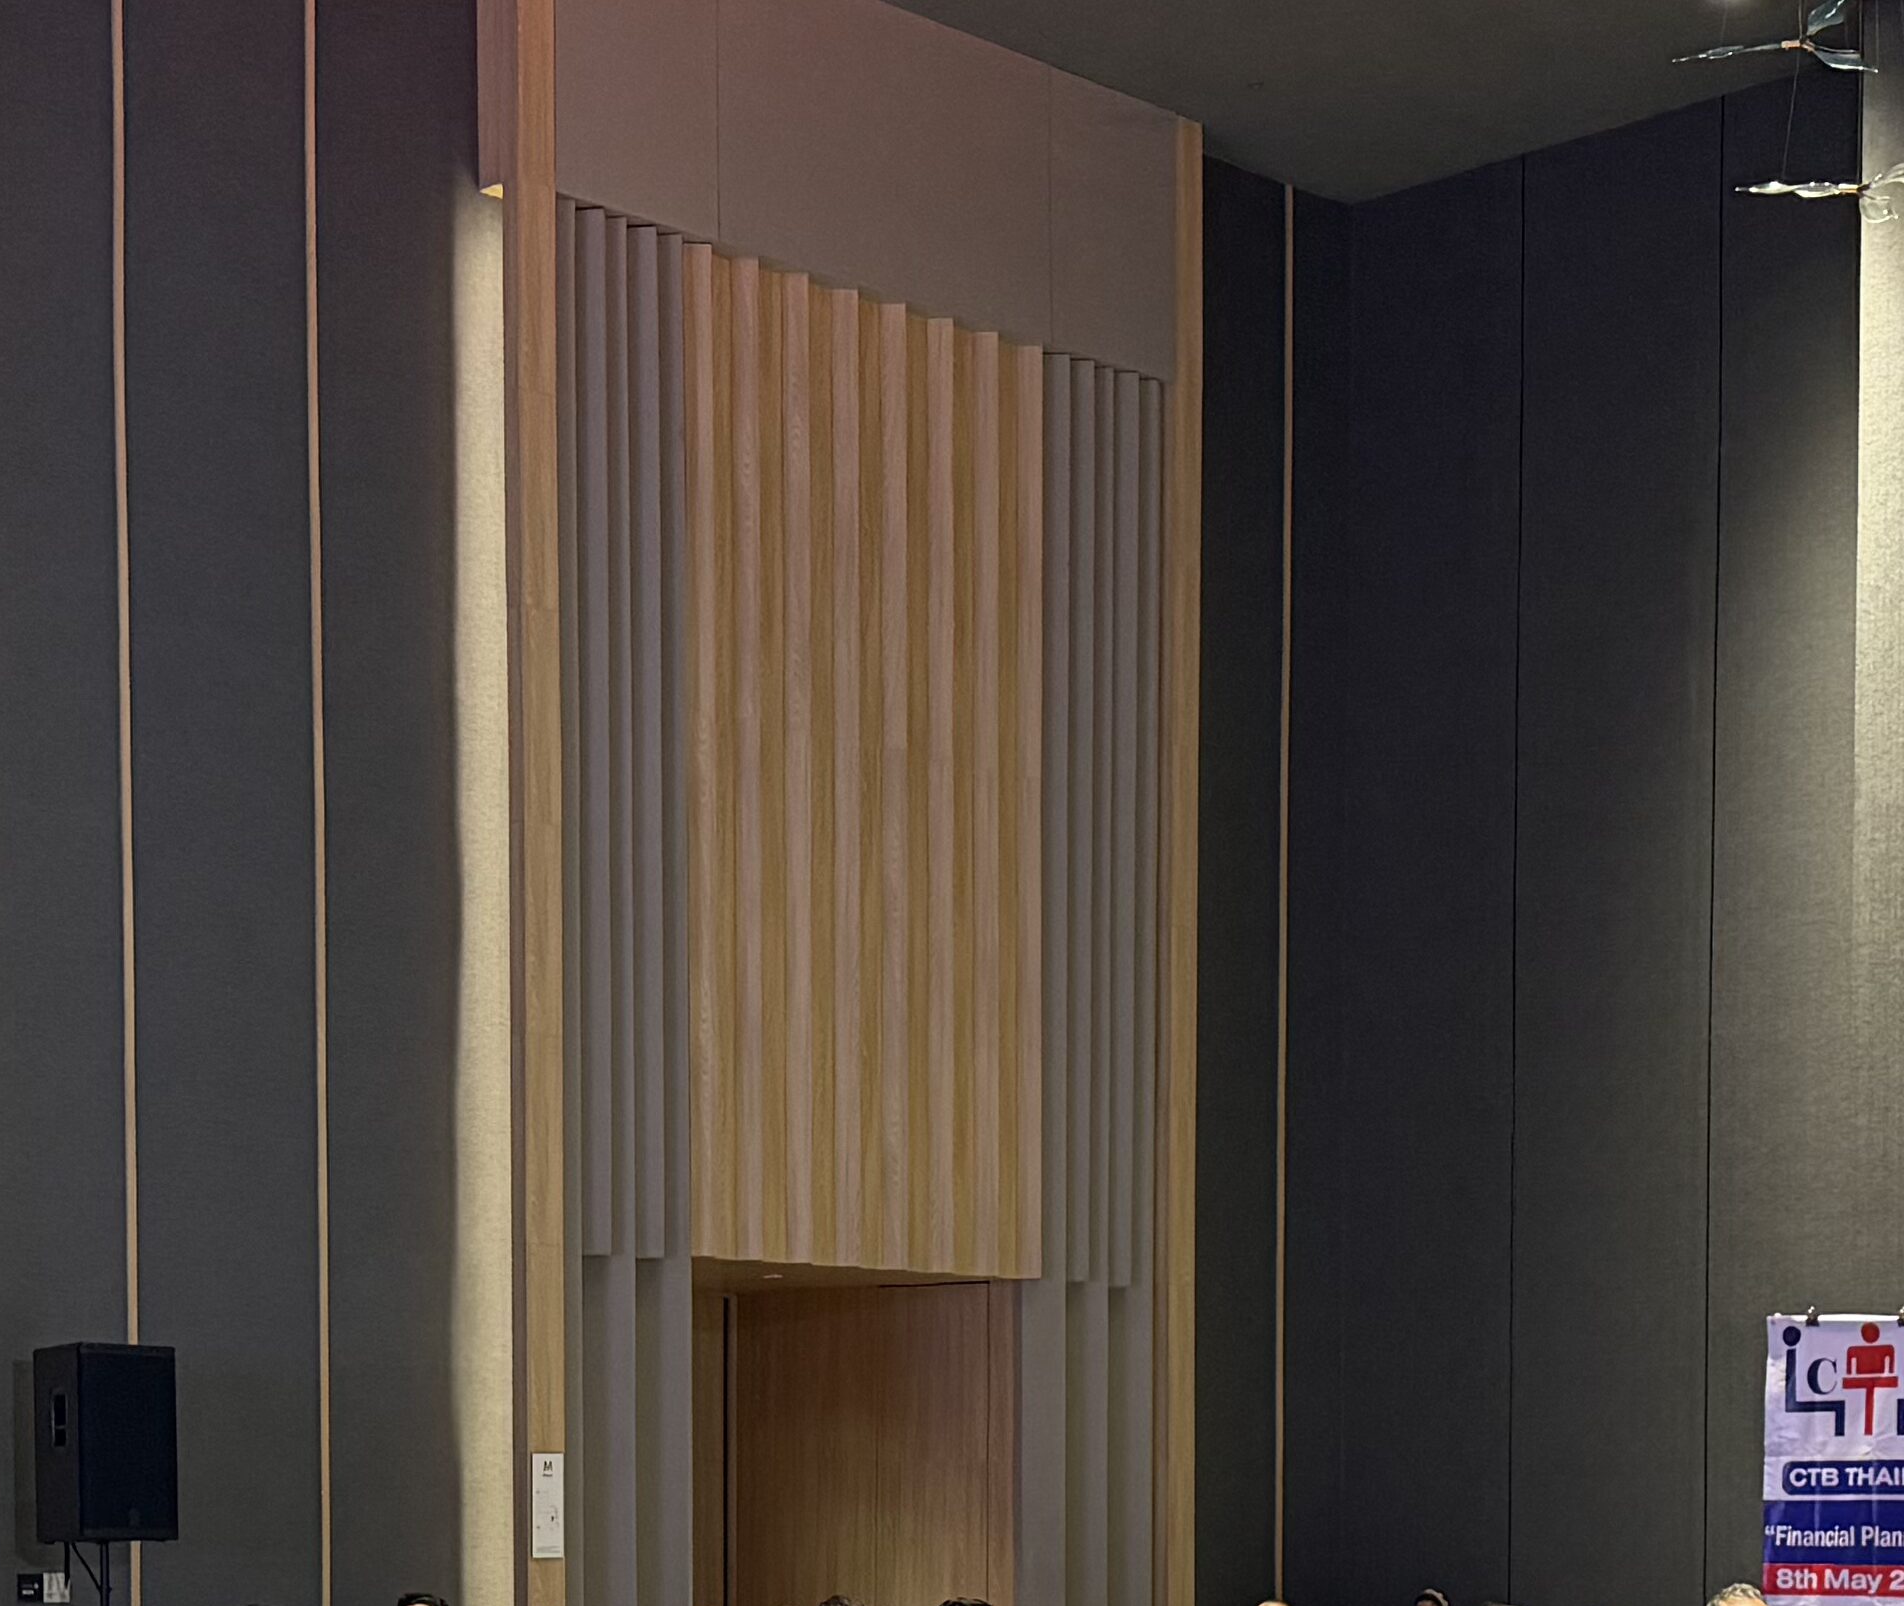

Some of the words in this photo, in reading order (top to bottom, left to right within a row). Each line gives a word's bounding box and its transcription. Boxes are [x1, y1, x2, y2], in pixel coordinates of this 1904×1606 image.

[1789, 1467, 1839, 1488] CTB
[1776, 1568, 1817, 1589] 8th
[1823, 1569, 1883, 1595] May
